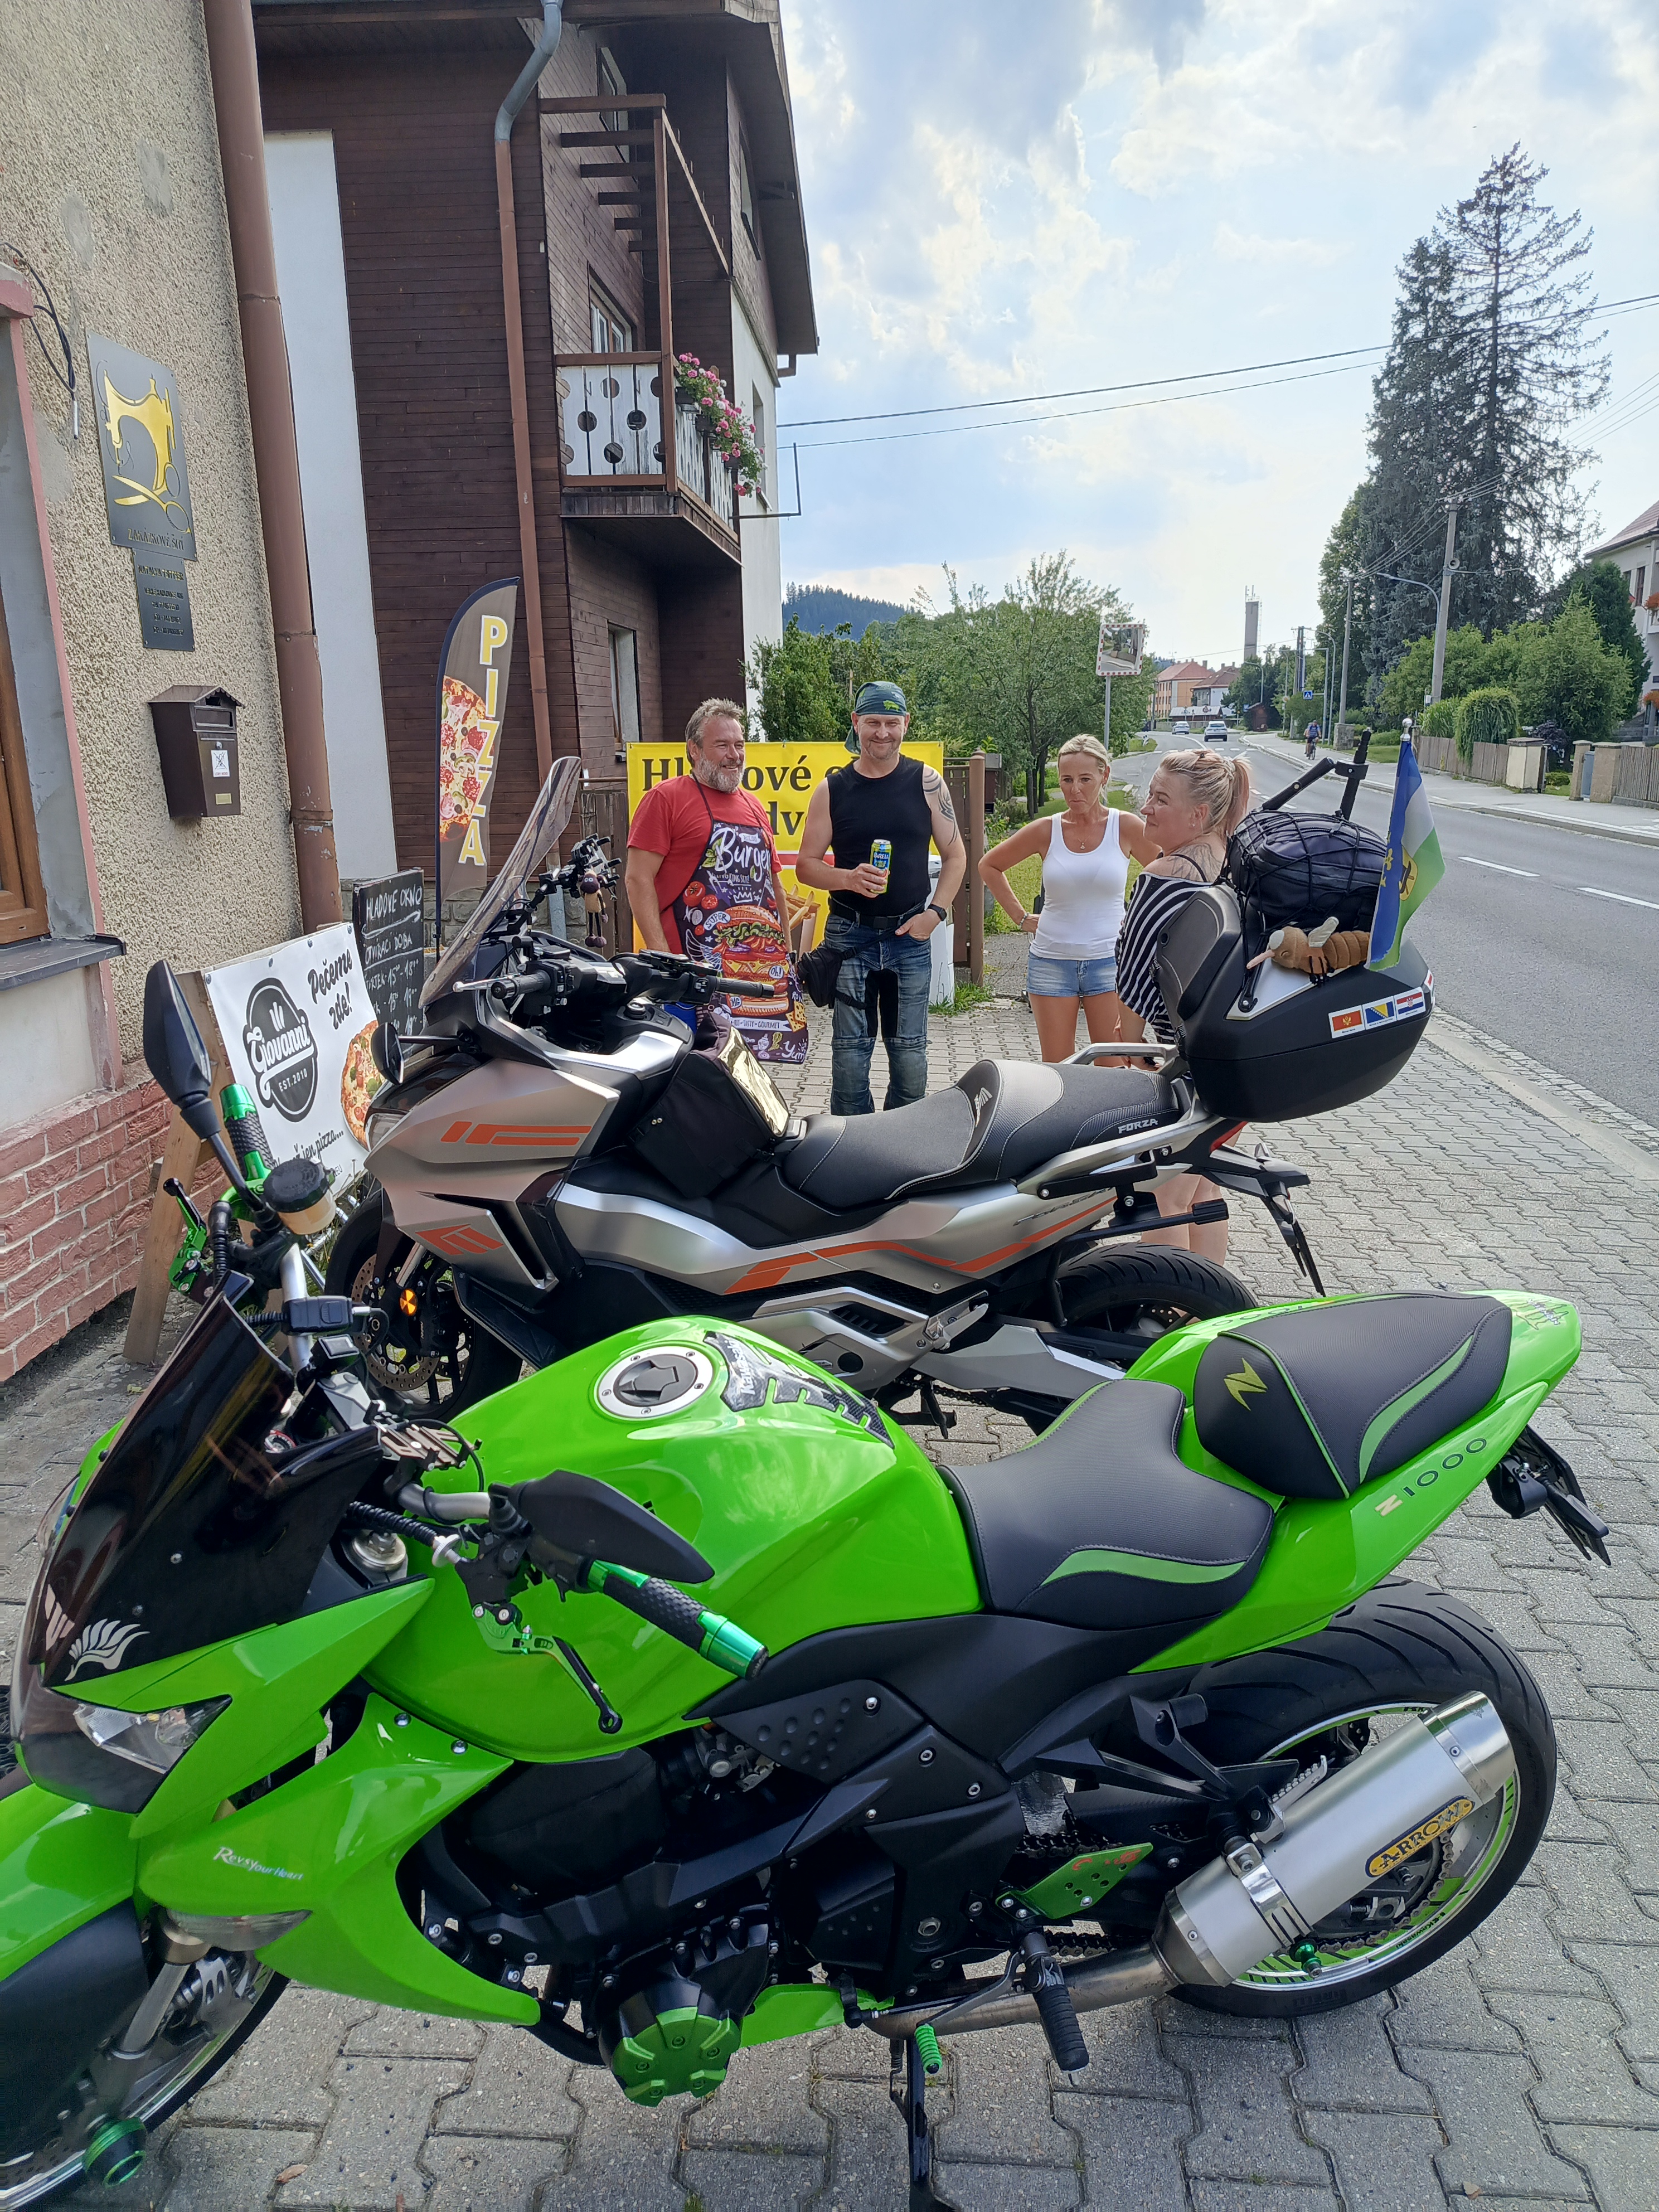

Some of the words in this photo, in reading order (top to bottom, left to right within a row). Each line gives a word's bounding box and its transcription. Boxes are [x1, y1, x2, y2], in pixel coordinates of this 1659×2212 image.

[458, 614, 508, 866] PIZZA
[642, 755, 812, 792] Hlové
[400, 884, 423, 907] OKNO
[705, 913, 727, 929] SUPER
[394, 932, 413, 950] DOBA
[308, 949, 352, 1004] Pečeme
[365, 970, 386, 991] TVRTEK
[329, 982, 352, 1030] zde!
[247, 1016, 311, 1073] Giovanni
[1118, 1118, 1158, 1134] FORZA
[1379, 1802, 1461, 1869] ARROW
